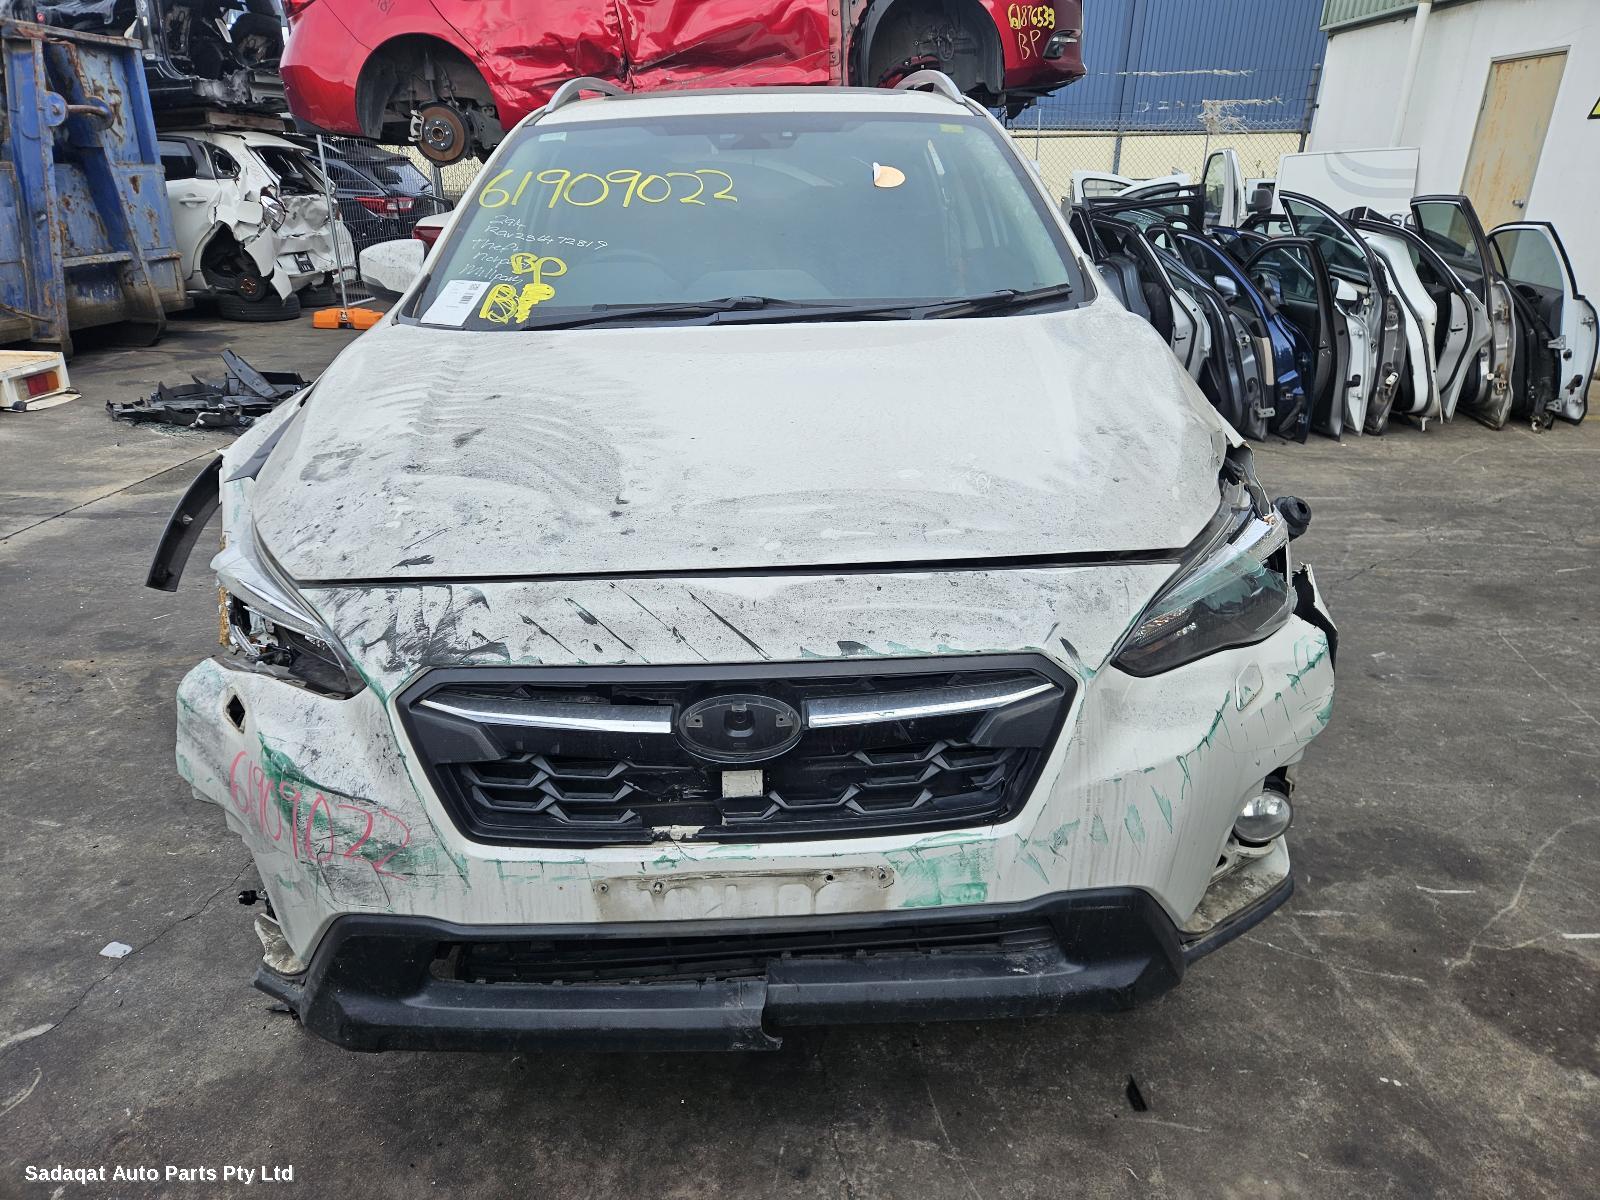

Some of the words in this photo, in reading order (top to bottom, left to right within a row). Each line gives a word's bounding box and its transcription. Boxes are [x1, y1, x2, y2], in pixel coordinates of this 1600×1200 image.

[1018, 29, 1041, 60] BP
[478, 168, 738, 208] 61909022
[229, 750, 413, 882] 61909022
